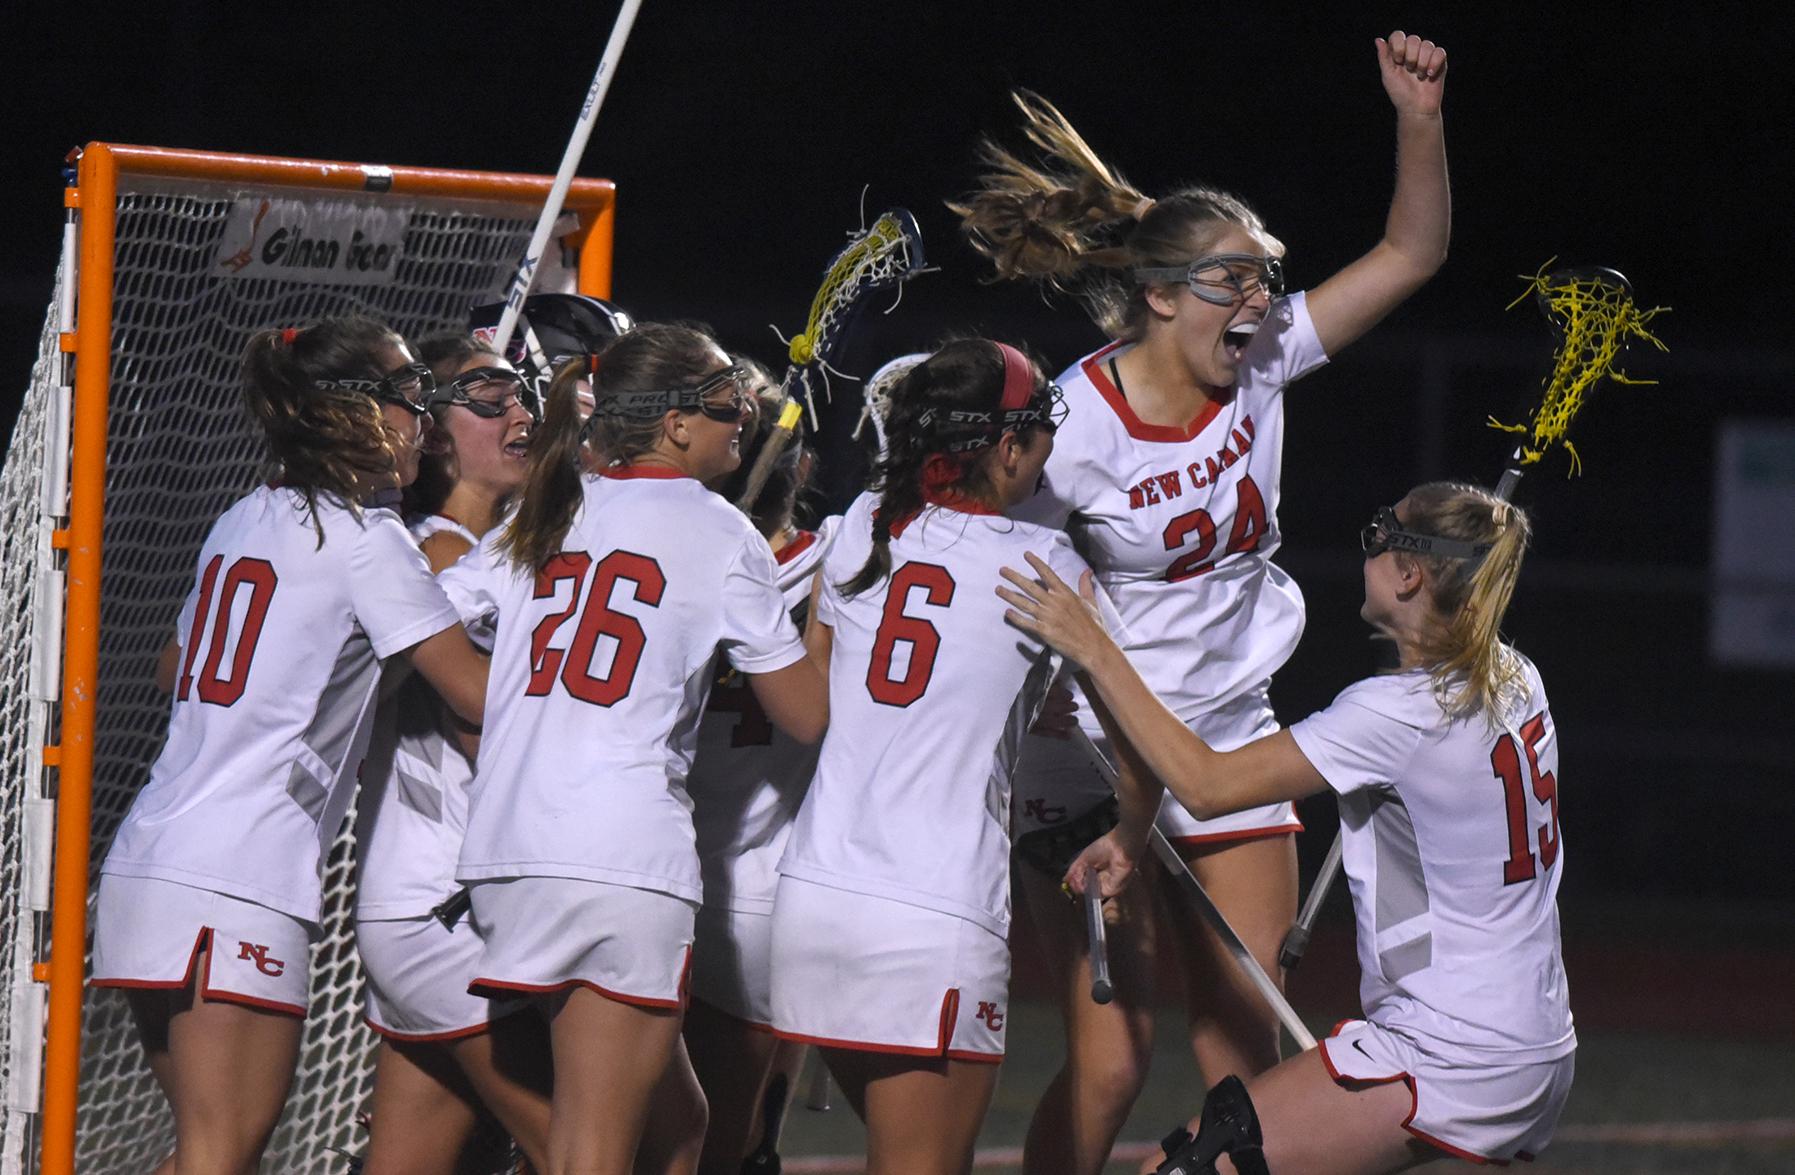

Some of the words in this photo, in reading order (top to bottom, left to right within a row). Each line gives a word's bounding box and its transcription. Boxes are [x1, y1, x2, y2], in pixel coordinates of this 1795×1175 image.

[262, 225, 340, 270] Gilman
[950, 411, 992, 423] STX
[1004, 409, 1041, 422] STX
[1129, 470, 1182, 510] NEW
[1160, 473, 1270, 584] 24
[176, 553, 279, 708] 10
[524, 549, 667, 708] 26
[866, 560, 956, 708] 6
[1490, 710, 1560, 886] 15
[237, 940, 285, 977] NC
[975, 1001, 1004, 1032] NC
